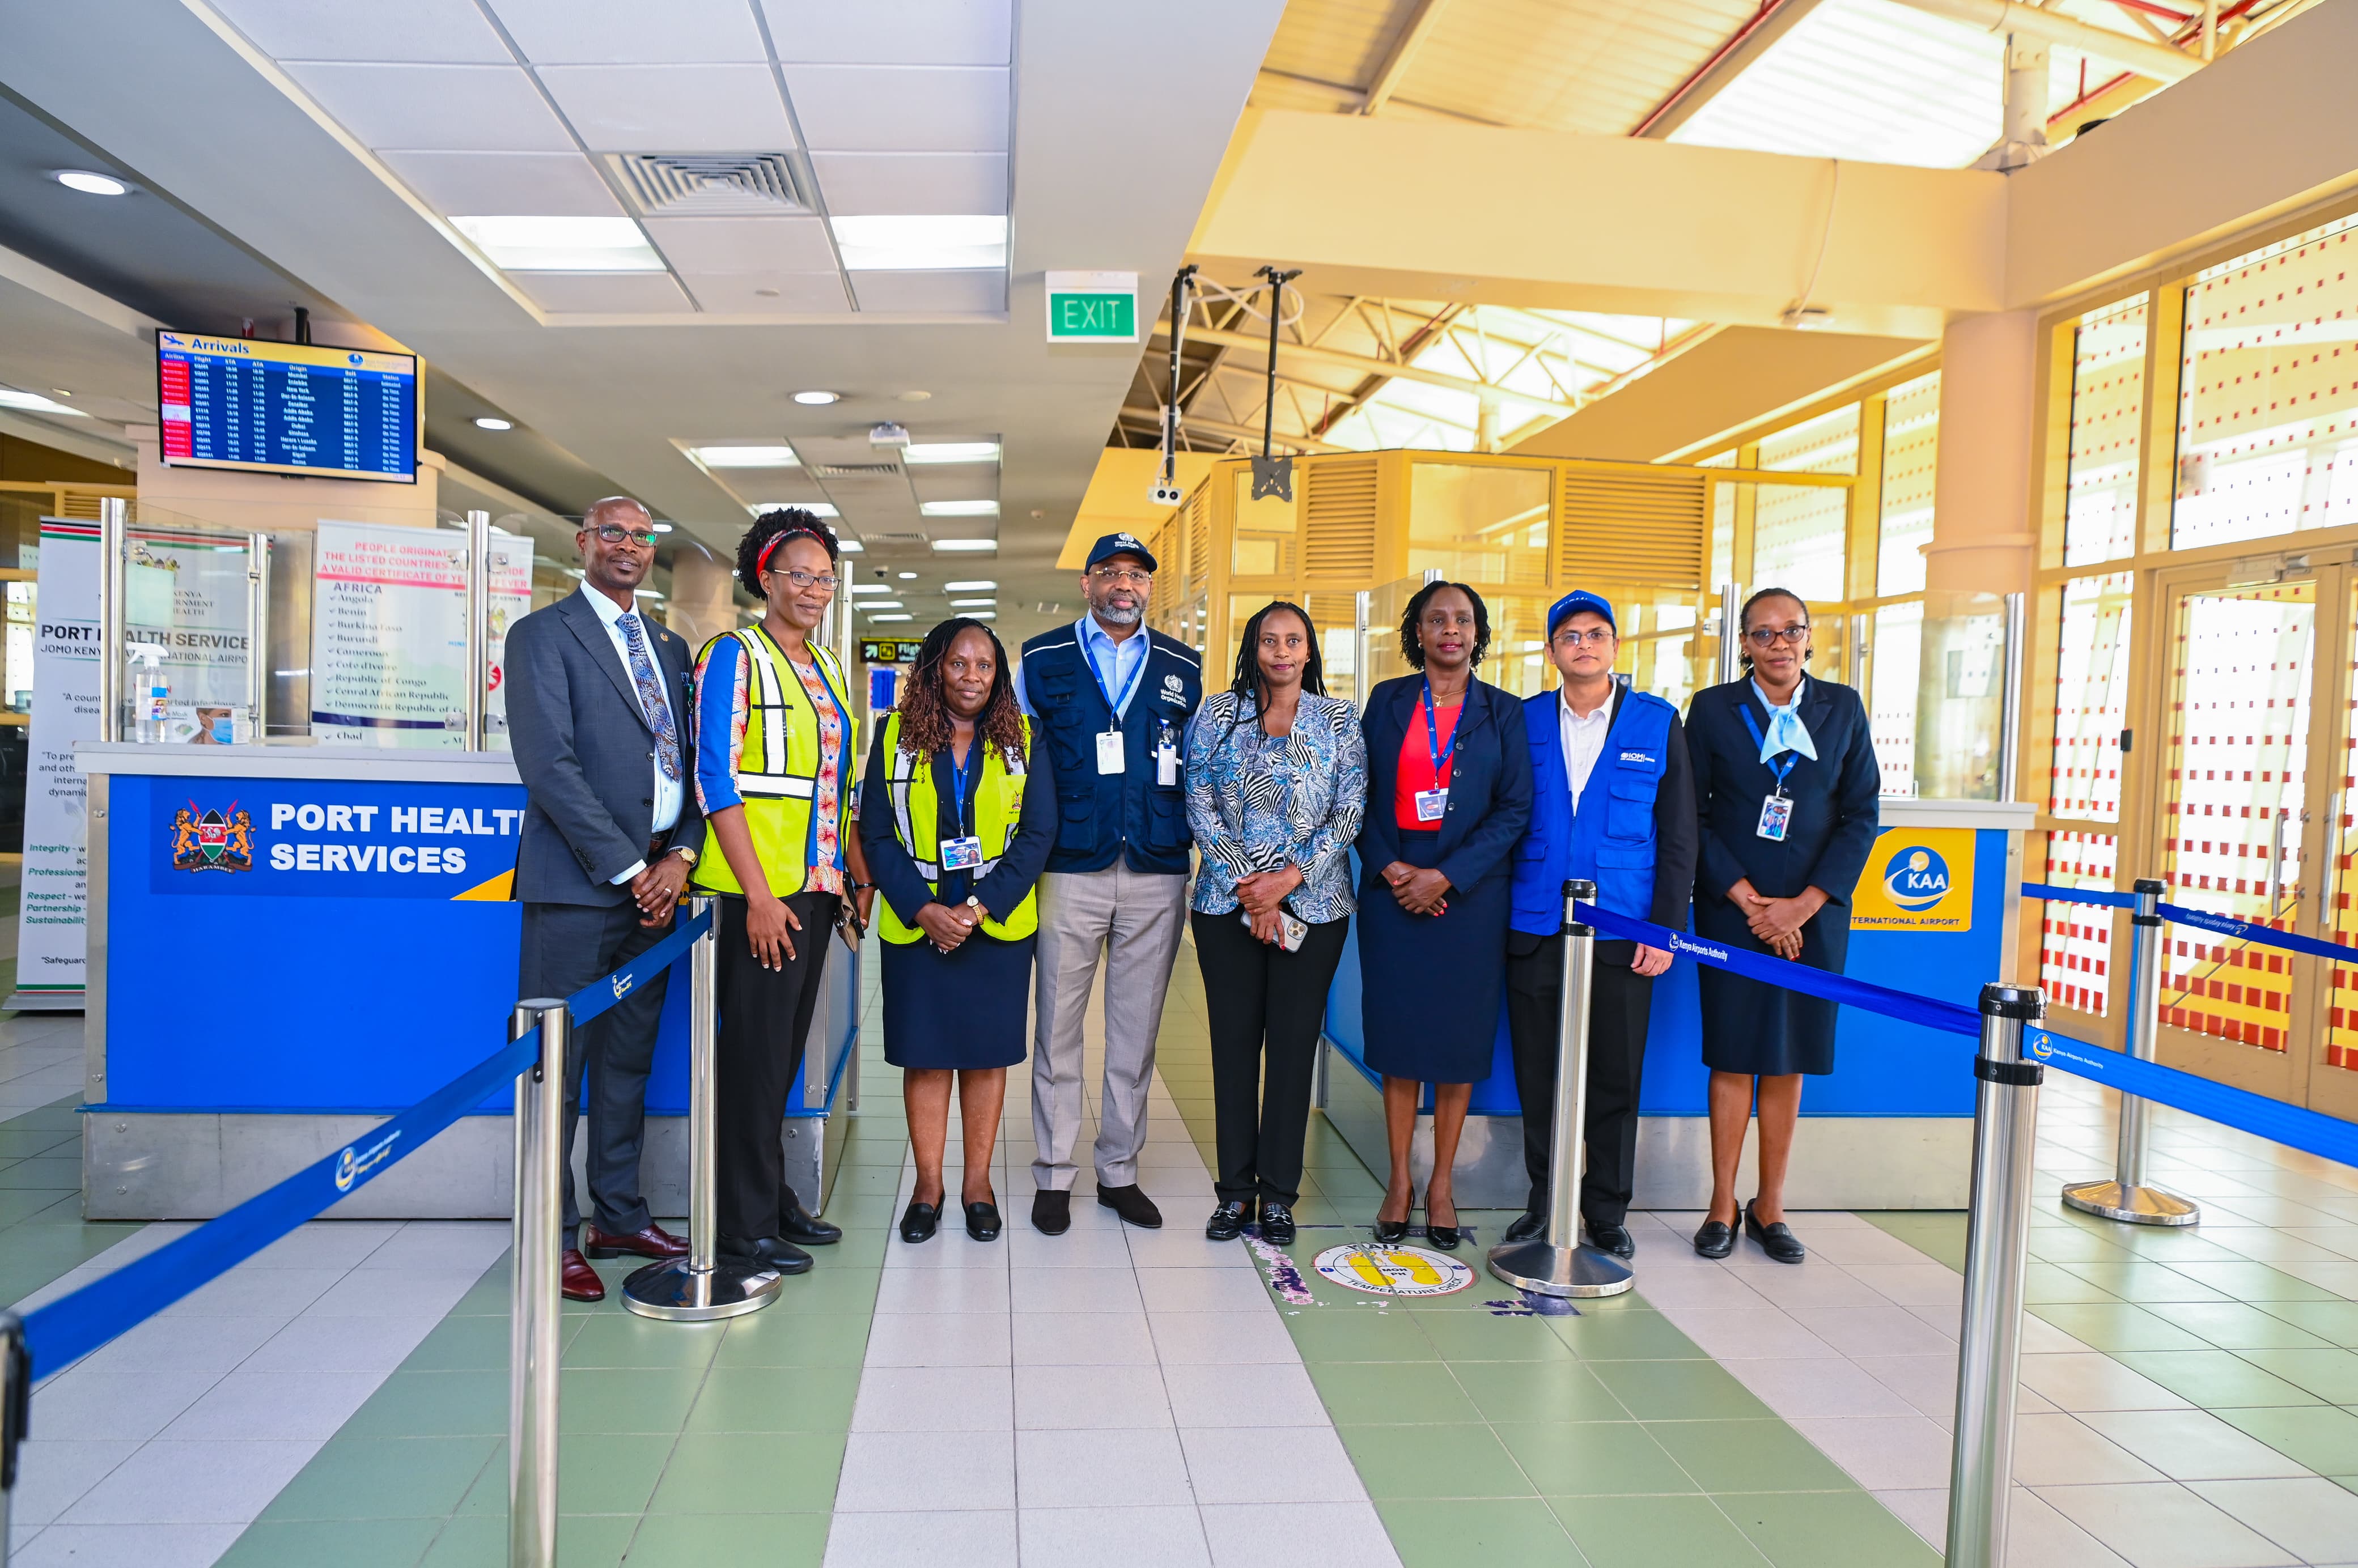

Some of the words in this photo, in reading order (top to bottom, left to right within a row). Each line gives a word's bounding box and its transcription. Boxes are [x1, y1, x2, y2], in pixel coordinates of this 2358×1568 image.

[1064, 300, 1120, 328] EXIT
[192, 338, 249, 354] Arrivals
[164, 352, 185, 360] Airline
[194, 355, 211, 364] Flight
[289, 364, 308, 373] Origin
[381, 373, 400, 382] Status
[355, 542, 396, 554] PEOPLE
[400, 545, 447, 557] ORIGINAT
[325, 551, 345, 562] THE
[349, 554, 385, 566] LISTED
[389, 556, 447, 570] COUNTRIES
[321, 564, 329, 572] A
[331, 565, 362, 576] VALID
[366, 568, 432, 581] CERTIFICATE
[435, 573, 448, 582] OF
[333, 582, 382, 594] AFRICA
[338, 594, 373, 604] Angola
[173, 607, 205, 617] EALTH
[338, 607, 367, 616] Benin
[337, 621, 378, 630] Burkina
[380, 623, 402, 632] Faso
[41, 624, 92, 640] PORT
[97, 628, 171, 645] ALTH
[337, 634, 378, 644] Burundi
[41, 644, 71, 653] JOMO
[218, 654, 248, 664] AIRPO
[336, 647, 389, 657] Cameroon
[898, 643, 921, 655] Fligh
[336, 660, 358, 669] Cote
[336, 674, 378, 685] Republic
[396, 678, 427, 687] Congo
[370, 689, 406, 699] African
[409, 691, 449, 701] Republic
[1160, 689, 1174, 698] World
[334, 700, 392, 711] Democratic
[395, 703, 435, 713] Republic
[1160, 695, 1186, 708] Organization
[337, 731, 362, 741] Chad
[54, 776, 87, 785] interna
[271, 802, 379, 832] PORT
[29, 844, 70, 853] Integrity
[269, 843, 466, 874] SERVICES
[192, 865, 234, 873] HARAMBEE
[1908, 873, 1947, 889] KAA
[27, 892, 66, 901] Respect
[26, 904, 82, 913] Partnership
[1851, 916, 1916, 925] TERNATIONAL
[1679, 939, 1692, 953] Kenya
[1692, 943, 1708, 956] Airports
[1708, 948, 1728, 962] Authority
[2041, 1044, 2051, 1052] KAA
[2053, 1048, 2066, 1057] Kenya
[2066, 1052, 2083, 1062] Airports
[2084, 1057, 2104, 1070] Authority
[1347, 1280, 1439, 1295] TEMPERATURE
[1439, 1277, 1464, 1291] CHECK
